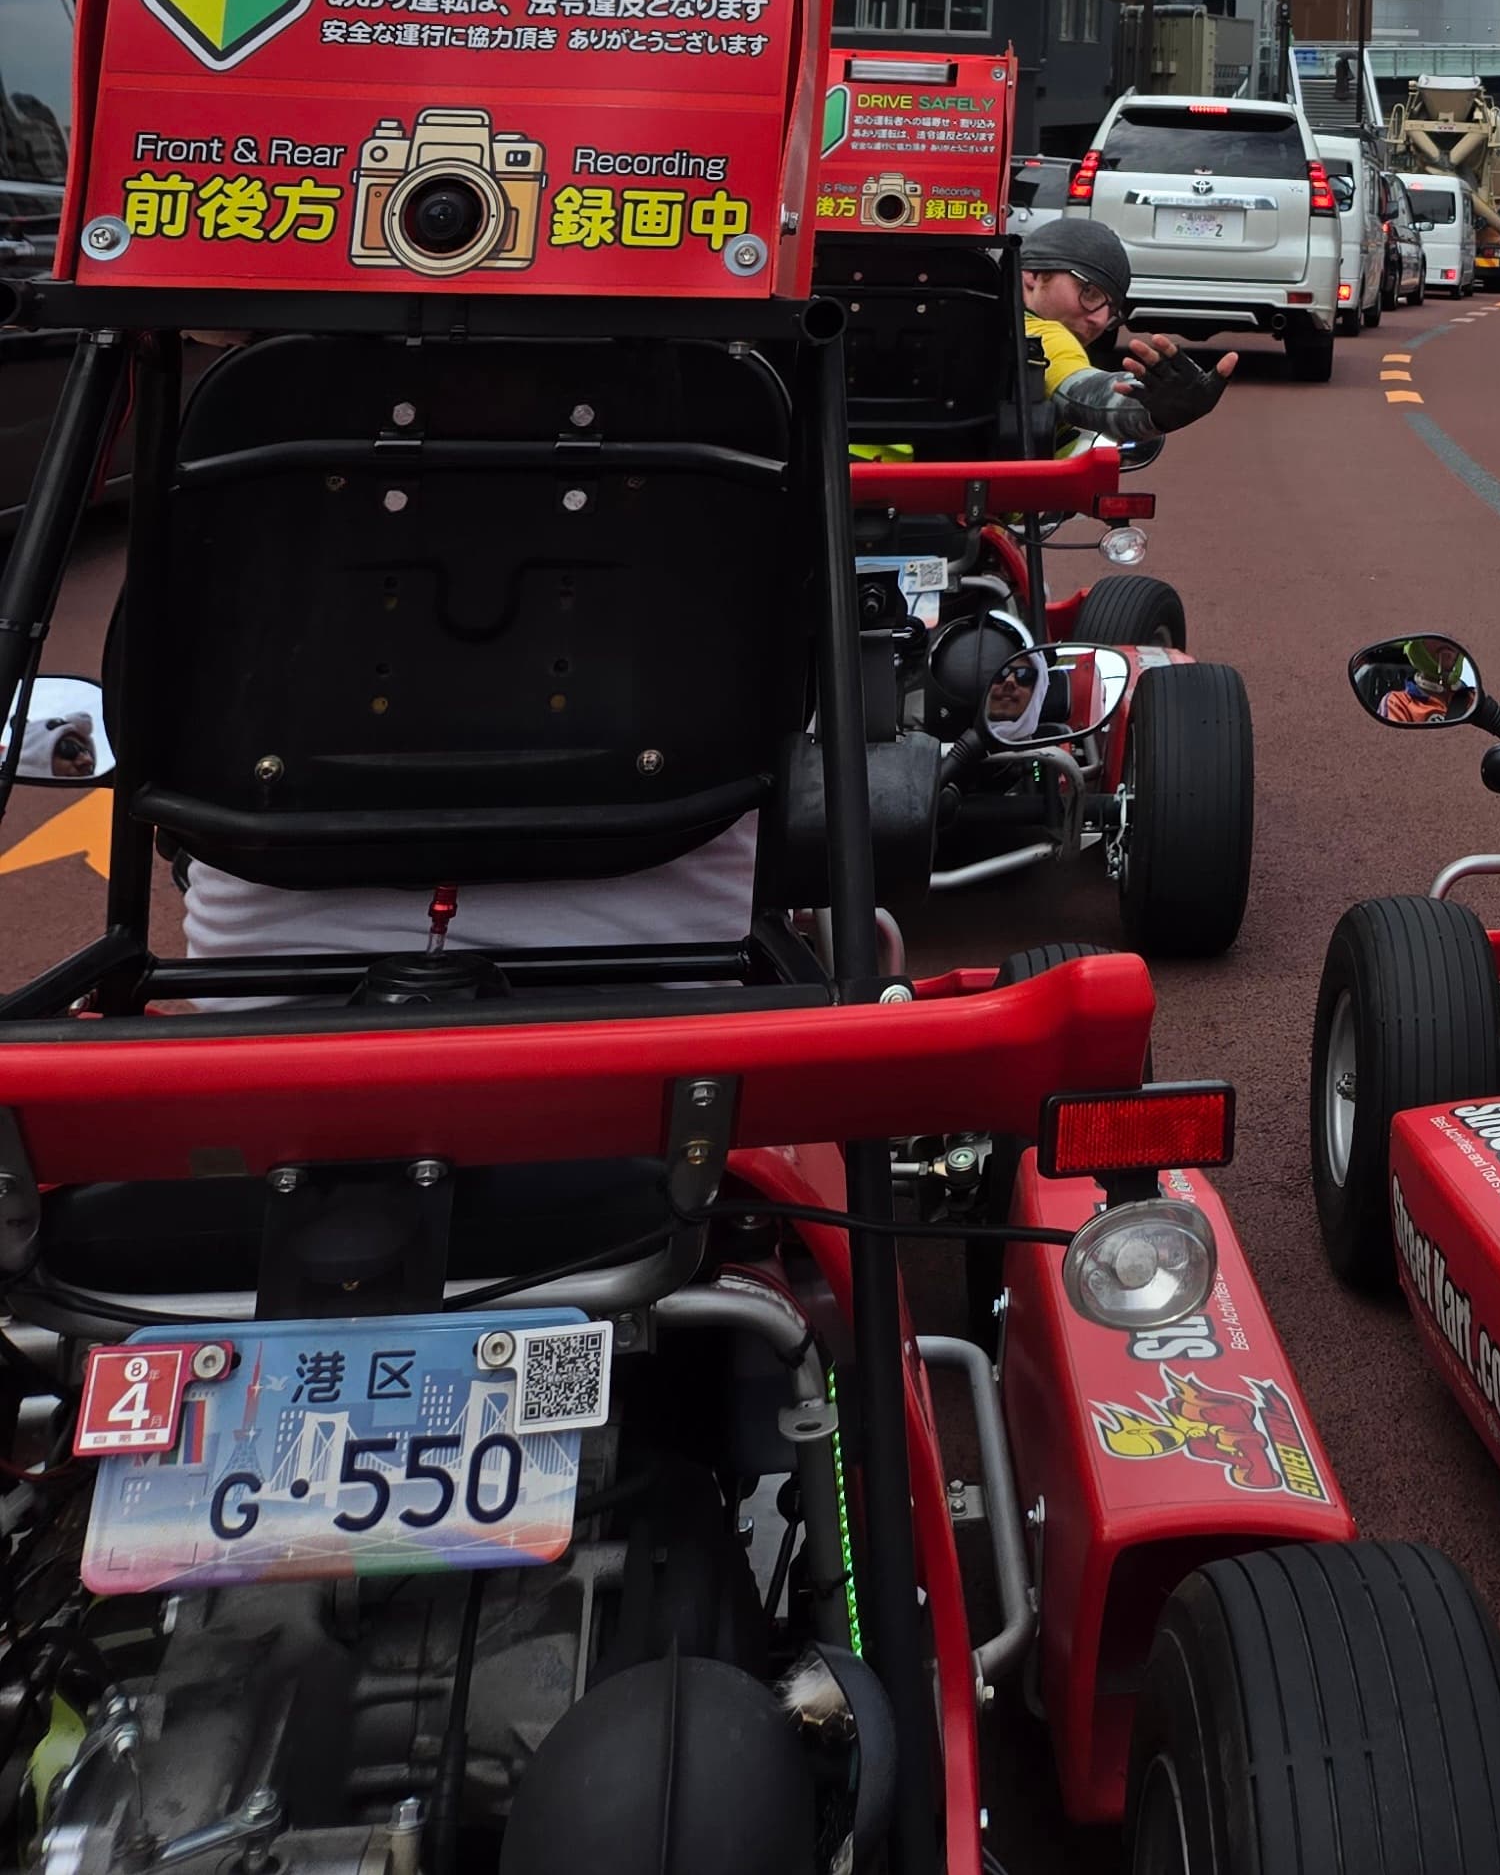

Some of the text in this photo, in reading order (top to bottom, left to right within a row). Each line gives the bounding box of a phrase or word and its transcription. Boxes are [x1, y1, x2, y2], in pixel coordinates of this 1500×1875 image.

[322, 21, 768, 56] 安全な運行に協力頂き ありがとうございます
[857, 94, 994, 112] DRIVE SAFELY
[136, 134, 345, 168] Front & Rear
[574, 149, 726, 181] Recording
[125, 173, 342, 241] 前後方
[925, 198, 989, 220] 録画中
[931, 186, 981, 198] Recording
[552, 188, 749, 250] 録画中
[1467, 1154, 1489, 1168] and
[1393, 1174, 1433, 1313] Street
[1213, 1284, 1241, 1326] Activities
[1230, 1327, 1250, 1352] Best
[291, 1350, 417, 1403] 港区
[1277, 1441, 1319, 1498] STREET
